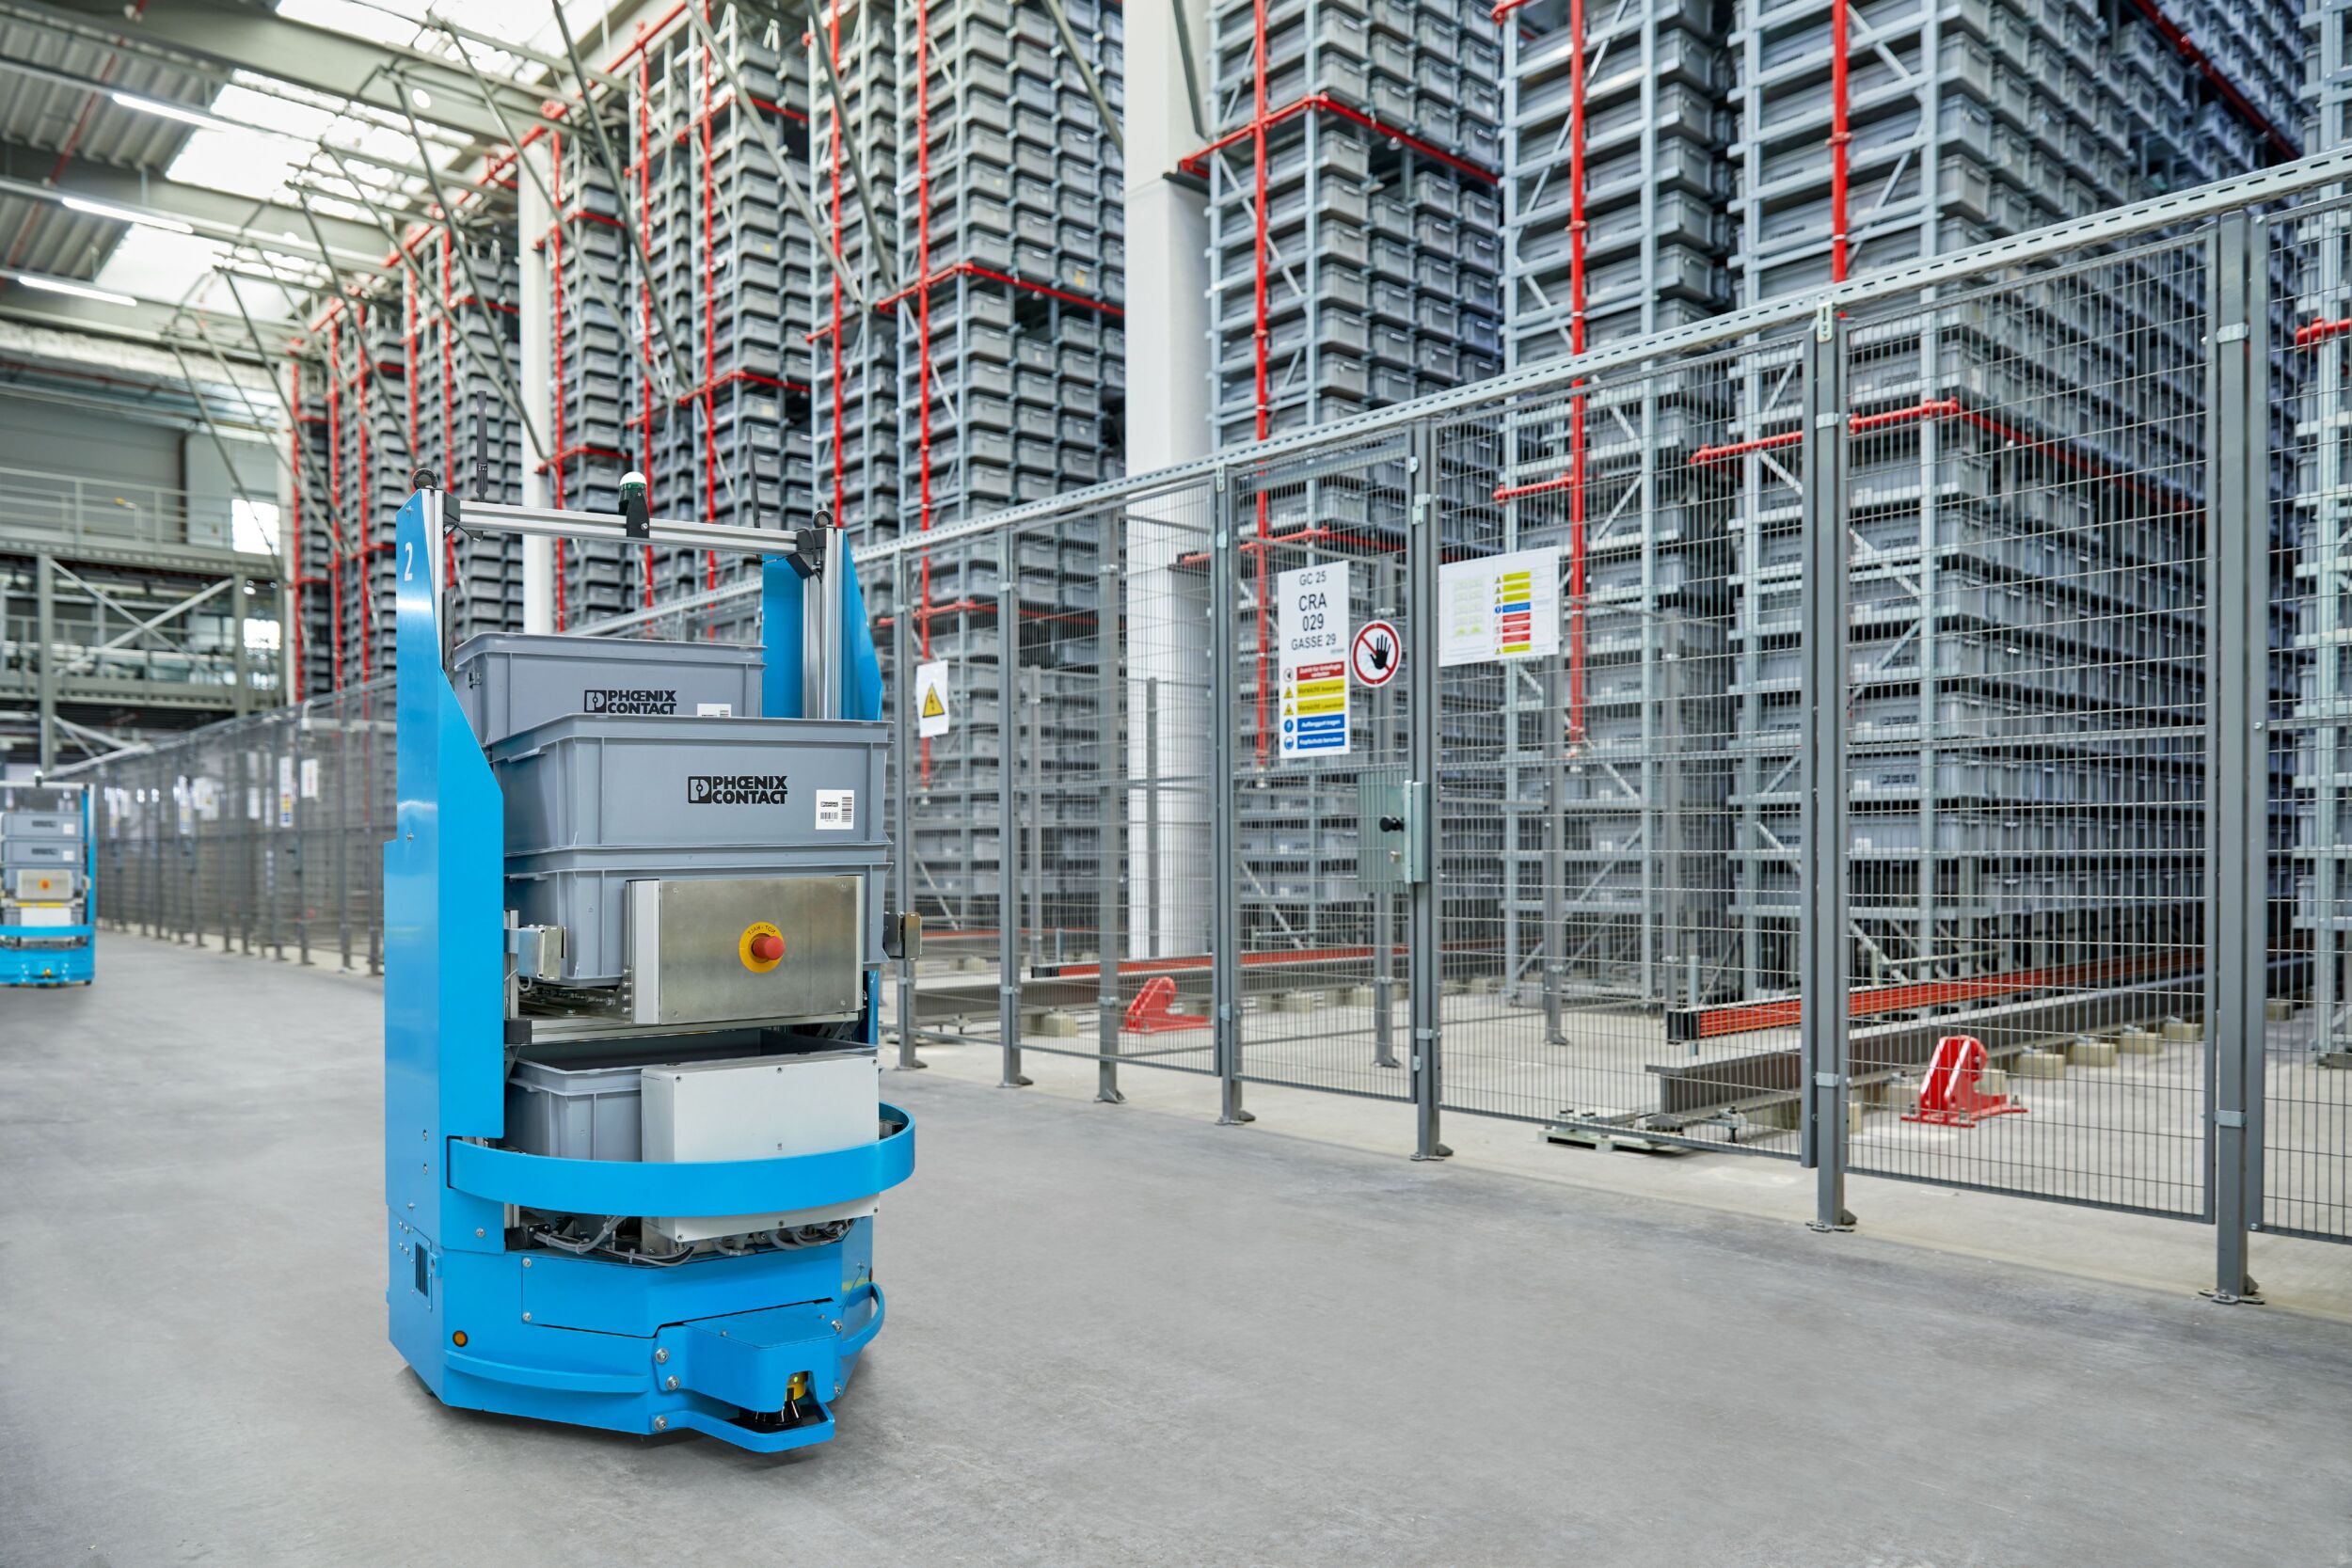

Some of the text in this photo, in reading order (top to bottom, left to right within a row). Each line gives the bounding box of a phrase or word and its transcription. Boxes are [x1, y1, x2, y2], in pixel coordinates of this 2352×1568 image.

[405, 542, 413, 581] 2
[1299, 570, 1326, 585] GC 25
[1298, 592, 1327, 611] CRA
[1302, 612, 1324, 631] 029
[1291, 633, 1336, 650] GASSE 29
[608, 702, 677, 715] CONTACT
[712, 790, 787, 804] CONTACT
